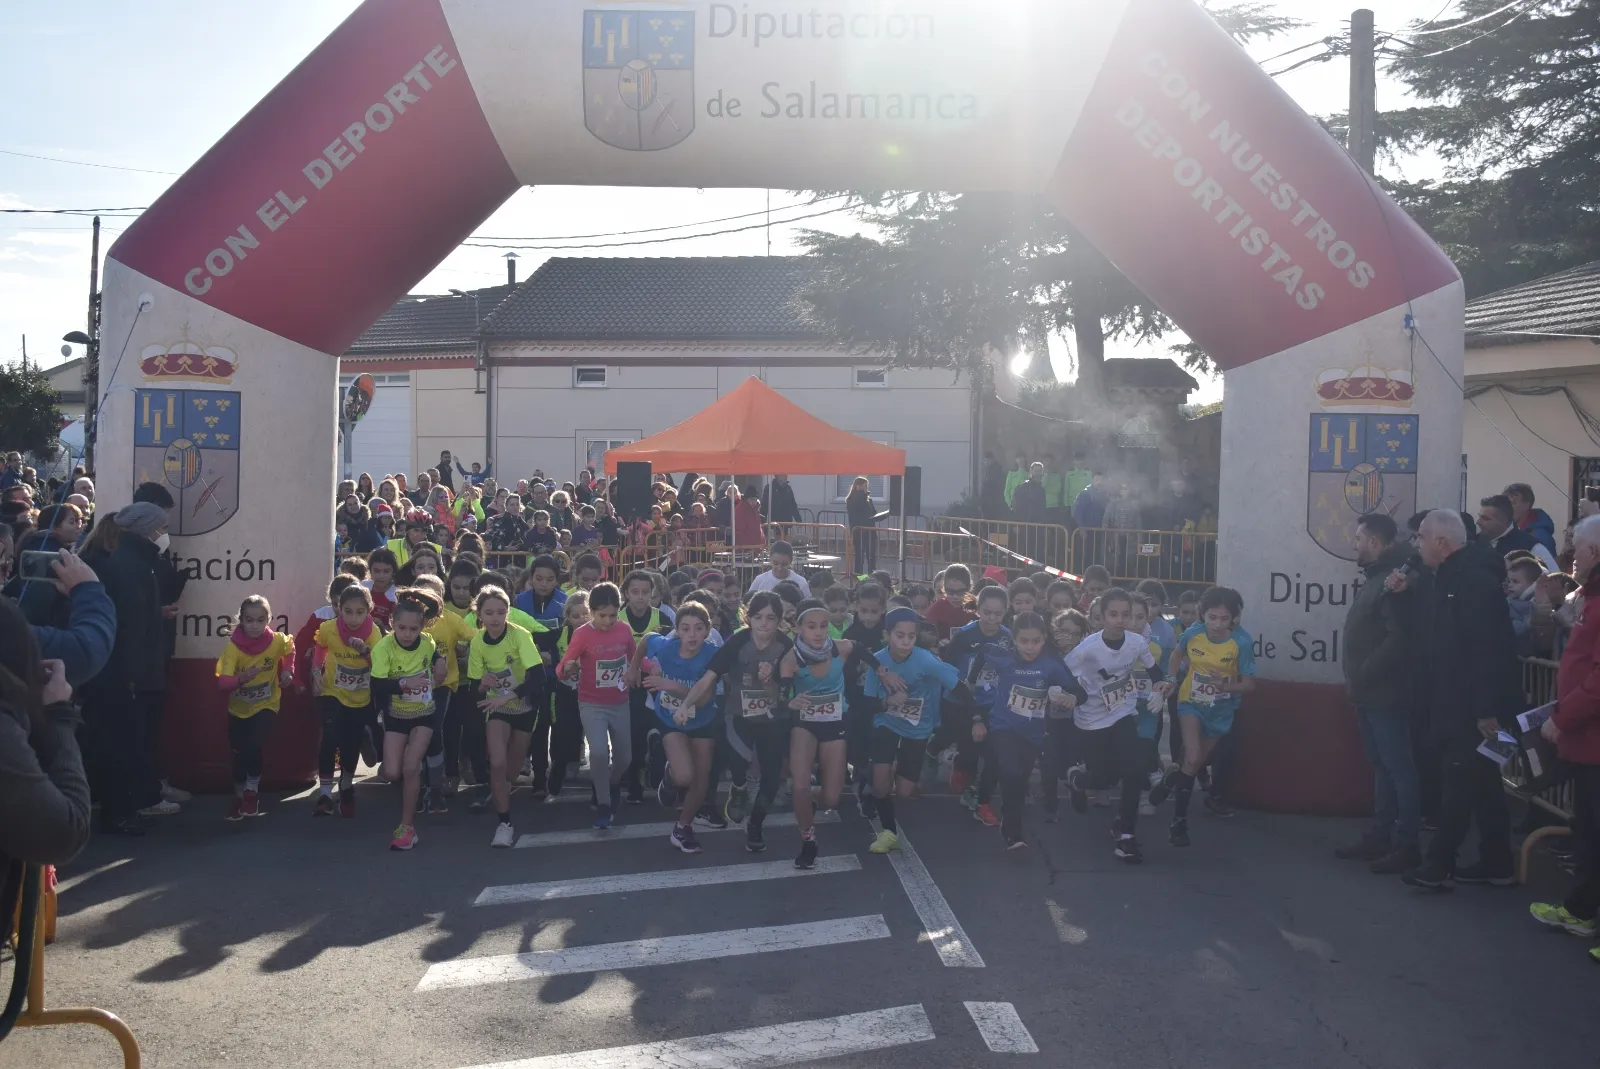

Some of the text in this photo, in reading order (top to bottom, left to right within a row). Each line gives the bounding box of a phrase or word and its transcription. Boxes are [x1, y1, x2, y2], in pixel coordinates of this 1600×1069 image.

[706, 80, 978, 120] de Salamanca
[184, 43, 458, 296] CON EL DEPORTE
[1144, 53, 1376, 290] CON NUESTROS
[1115, 98, 1326, 311] DEPORTISTAS
[1252, 633, 1276, 659] de
[340, 672, 365, 685] 896
[663, 692, 684, 707] 36
[806, 702, 836, 716] 543
